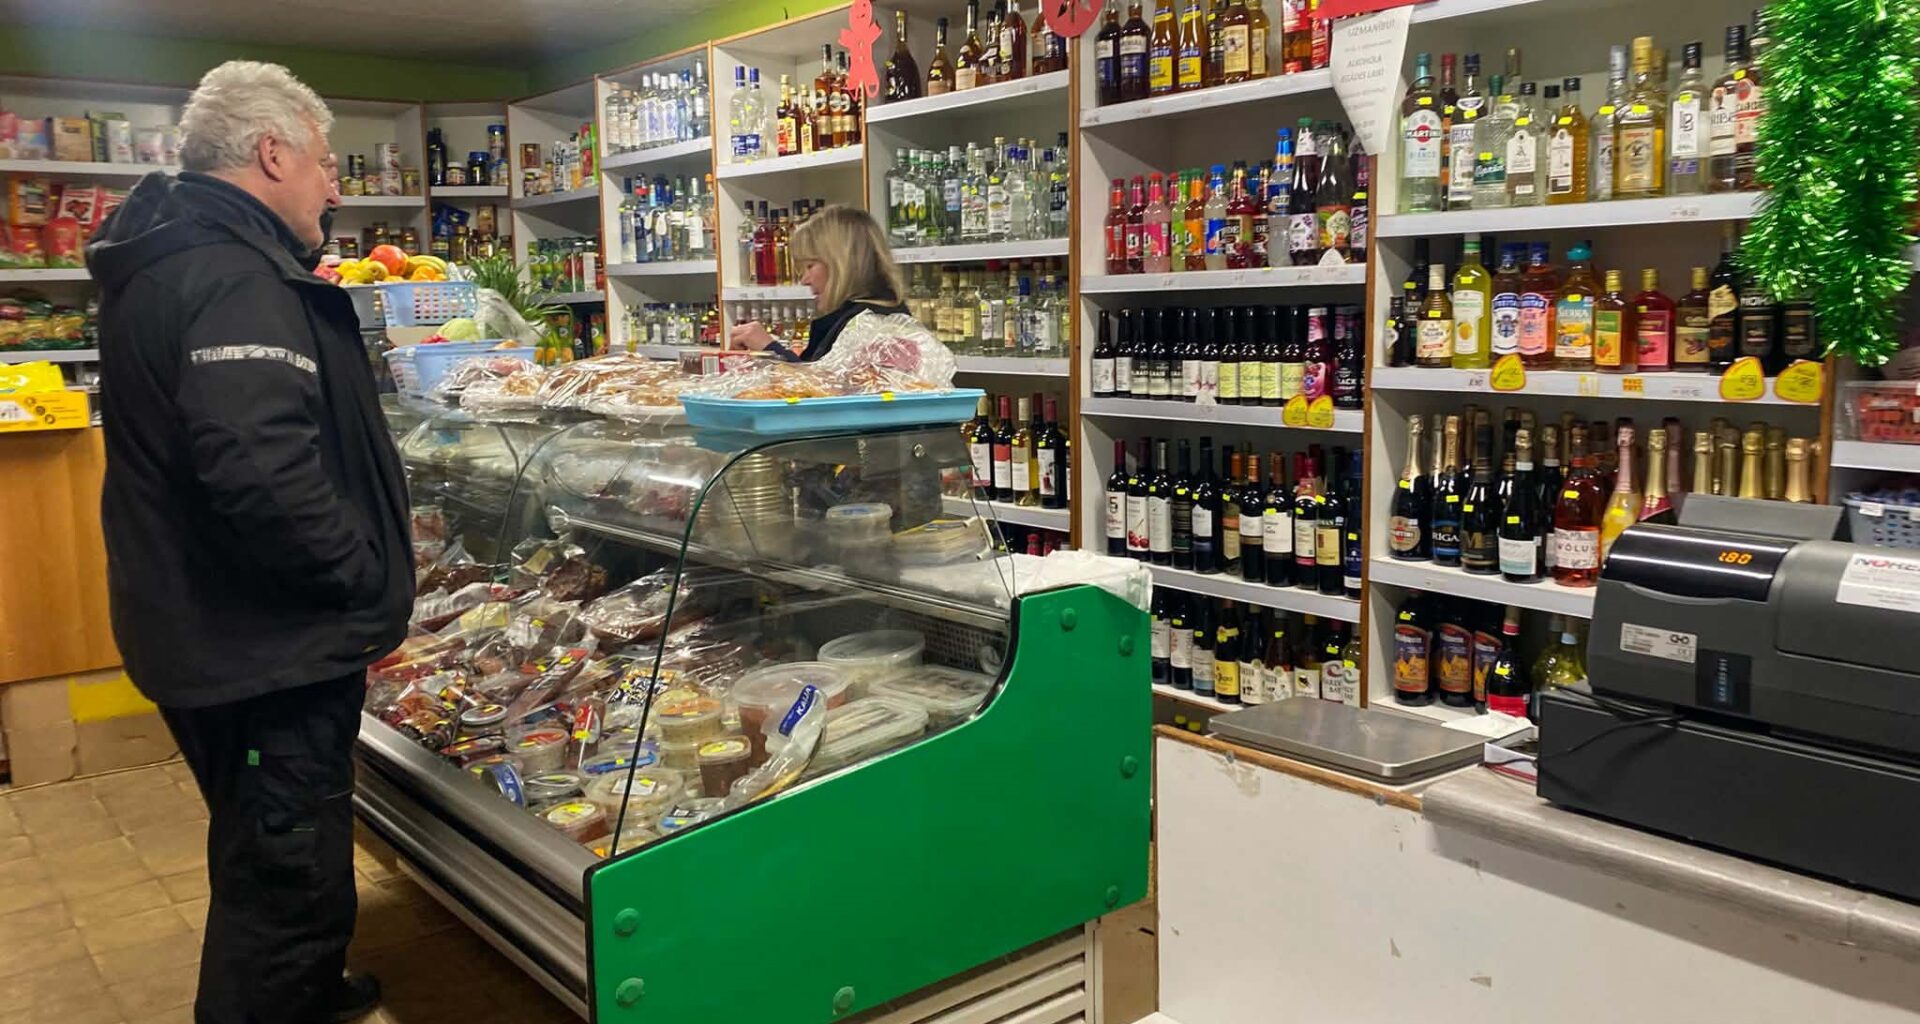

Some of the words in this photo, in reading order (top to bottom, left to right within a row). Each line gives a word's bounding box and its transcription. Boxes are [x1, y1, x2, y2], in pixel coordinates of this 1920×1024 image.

[1405, 129, 1440, 138] MARTINI
[1432, 531, 1460, 542] RIGA
[795, 686, 812, 717] KAIJA
